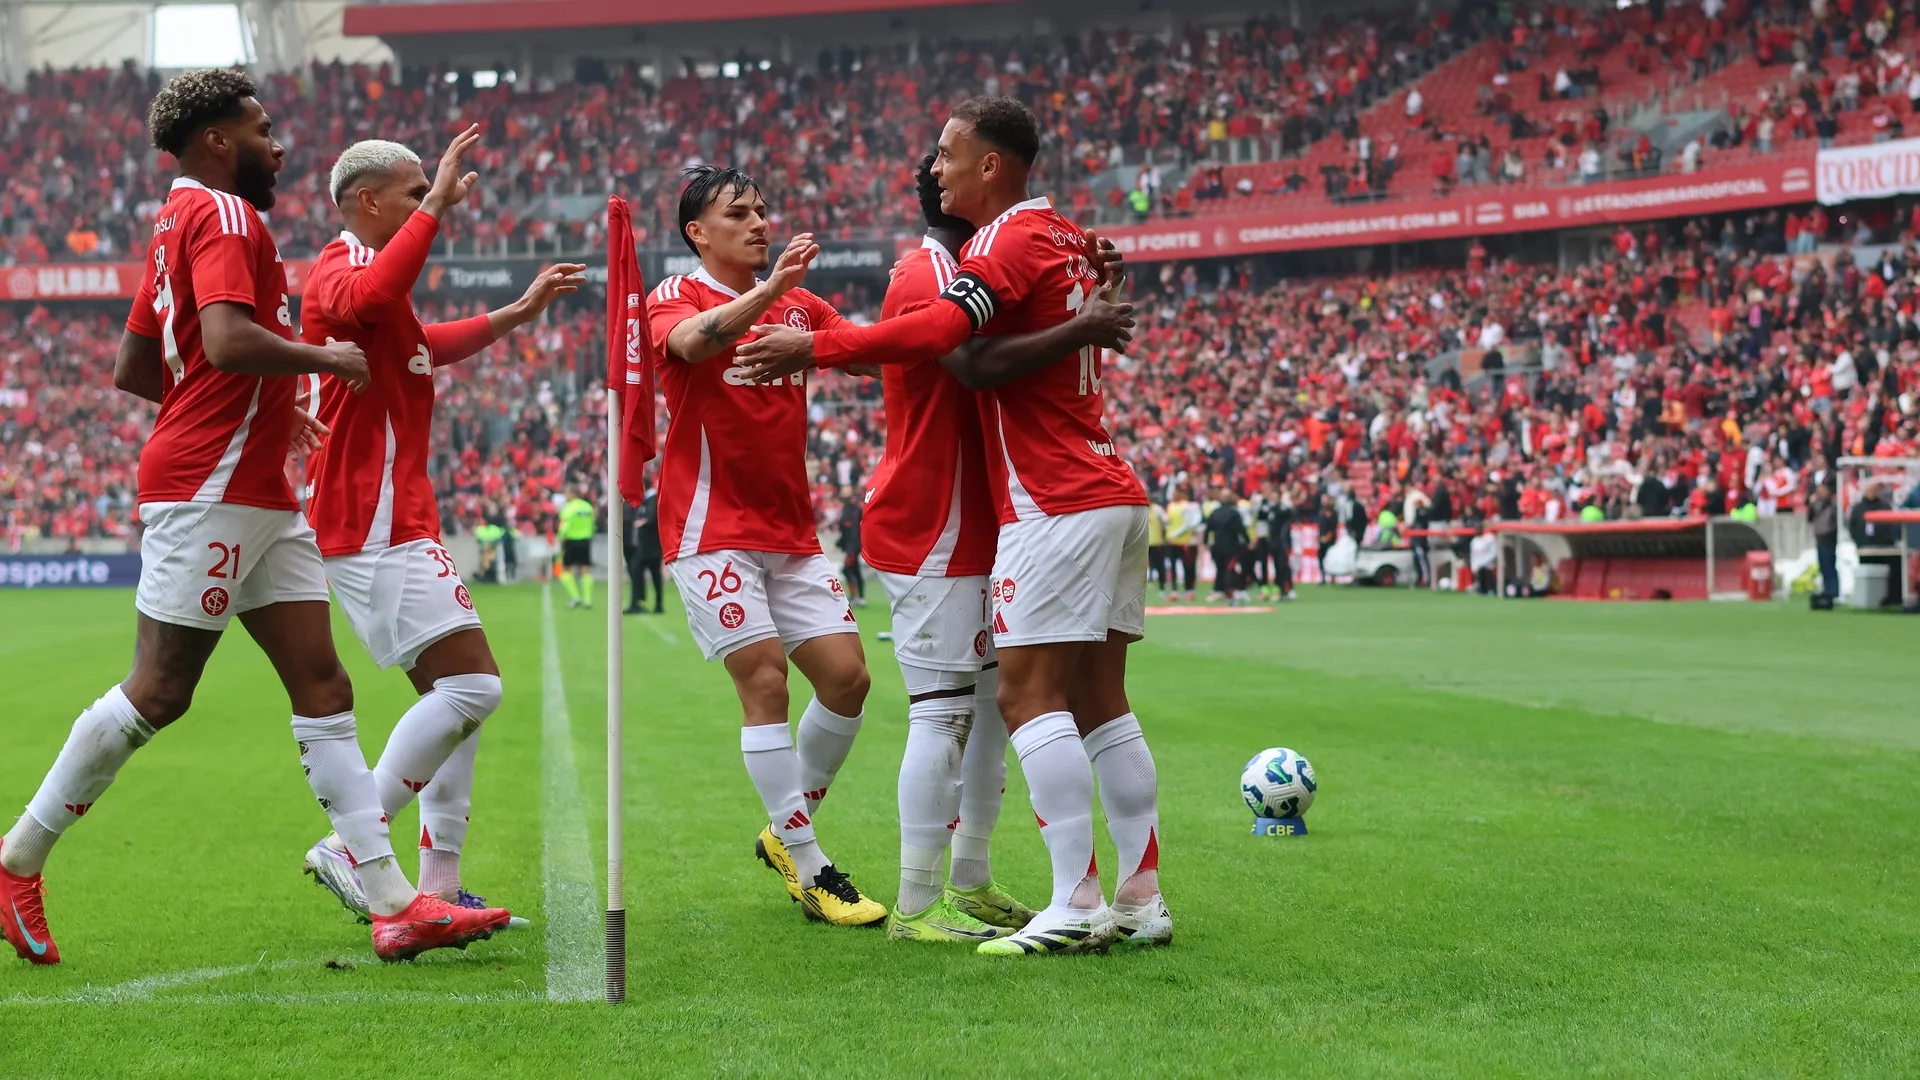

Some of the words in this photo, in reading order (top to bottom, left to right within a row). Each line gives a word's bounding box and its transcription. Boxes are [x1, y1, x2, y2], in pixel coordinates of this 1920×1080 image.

[1138, 230, 1200, 250] FORTE
[37, 266, 121, 297] ULBRA
[207, 541, 240, 580] 21
[426, 549, 458, 577] 35
[698, 561, 742, 602] 26
[1266, 824, 1295, 837] CBF
